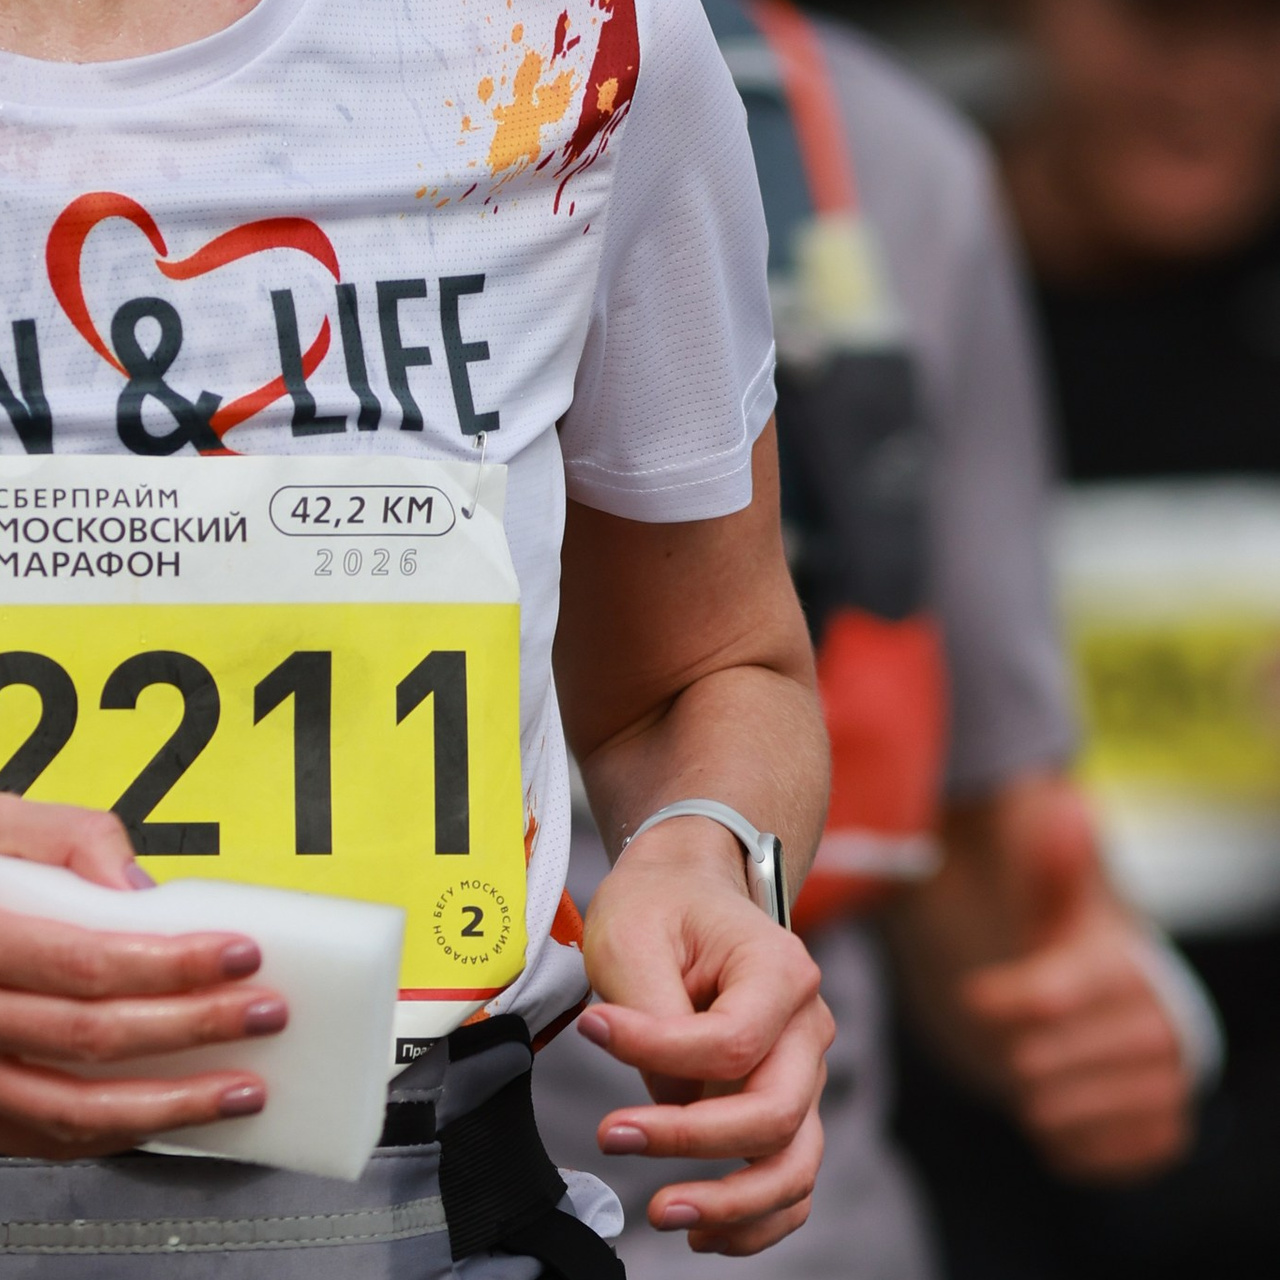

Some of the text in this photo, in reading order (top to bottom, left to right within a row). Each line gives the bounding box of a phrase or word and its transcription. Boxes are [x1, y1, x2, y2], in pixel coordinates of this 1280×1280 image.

[110, 296, 228, 455] &
[270, 273, 500, 437] LIFE
[290, 496, 434, 528] 42,2 КМ
[314, 548, 418, 576] 2026
[433, 879, 511, 965] БЕГУ МОСКОВСКИЙ МАРАФОН
[460, 905, 485, 937] 2
